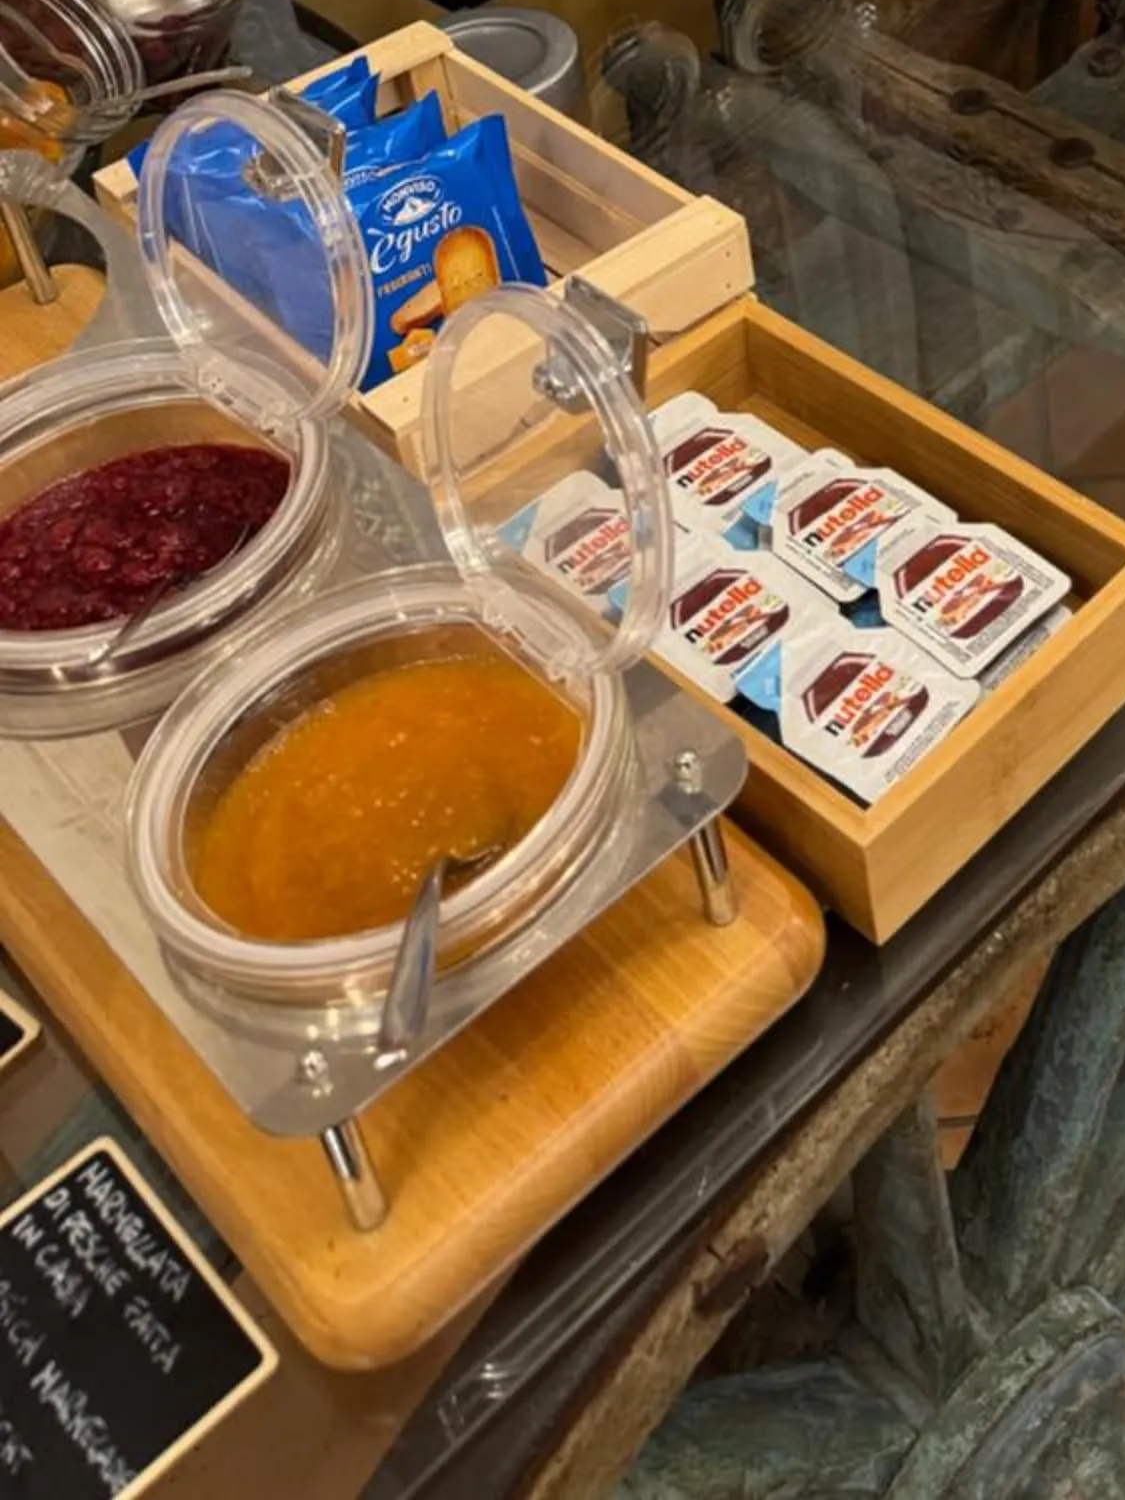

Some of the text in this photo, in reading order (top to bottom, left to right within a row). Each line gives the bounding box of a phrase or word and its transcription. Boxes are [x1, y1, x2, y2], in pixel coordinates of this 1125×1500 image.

[382, 180, 437, 213] MONVISO
[676, 436, 749, 489] nutella
[803, 484, 885, 548] nutella
[684, 576, 763, 645] nutella
[911, 546, 993, 615] nutella
[824, 665, 896, 738] nutella
[44, 1187, 71, 1219] DI
[11, 1213, 92, 1318] IN CASA
